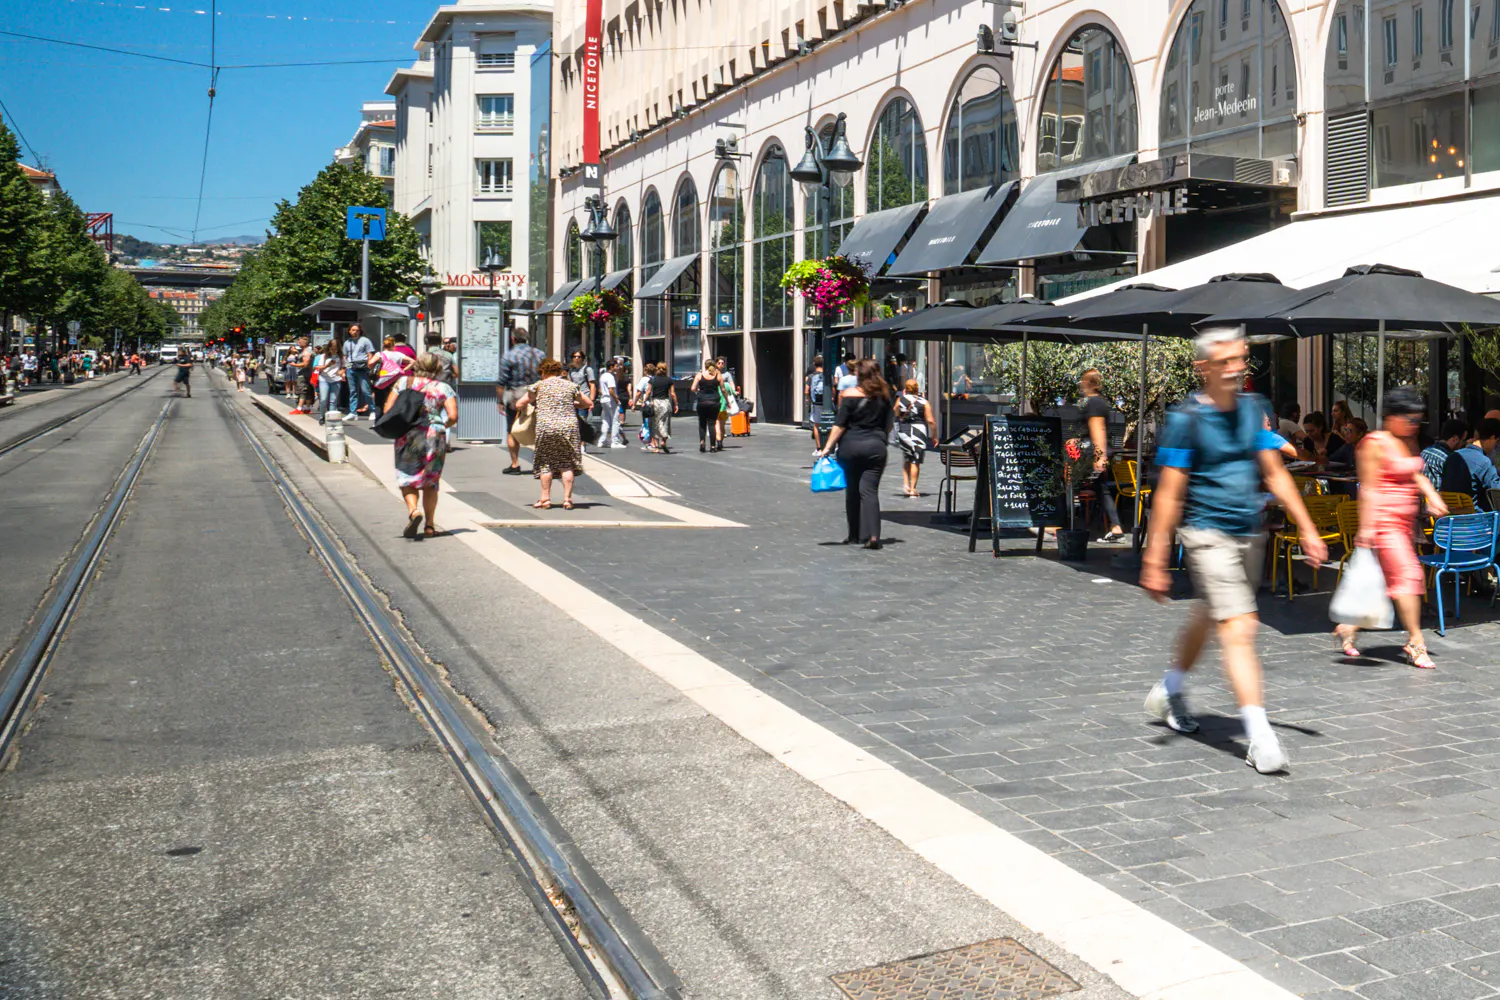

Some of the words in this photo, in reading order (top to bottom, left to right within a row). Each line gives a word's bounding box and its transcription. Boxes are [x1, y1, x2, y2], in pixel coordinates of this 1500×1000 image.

[587, 37, 597, 109] NICETOILE
[1194, 94, 1257, 123] Jean-Medecin
[1215, 82, 1235, 100] porte
[1077, 188, 1188, 229] NICETOILE
